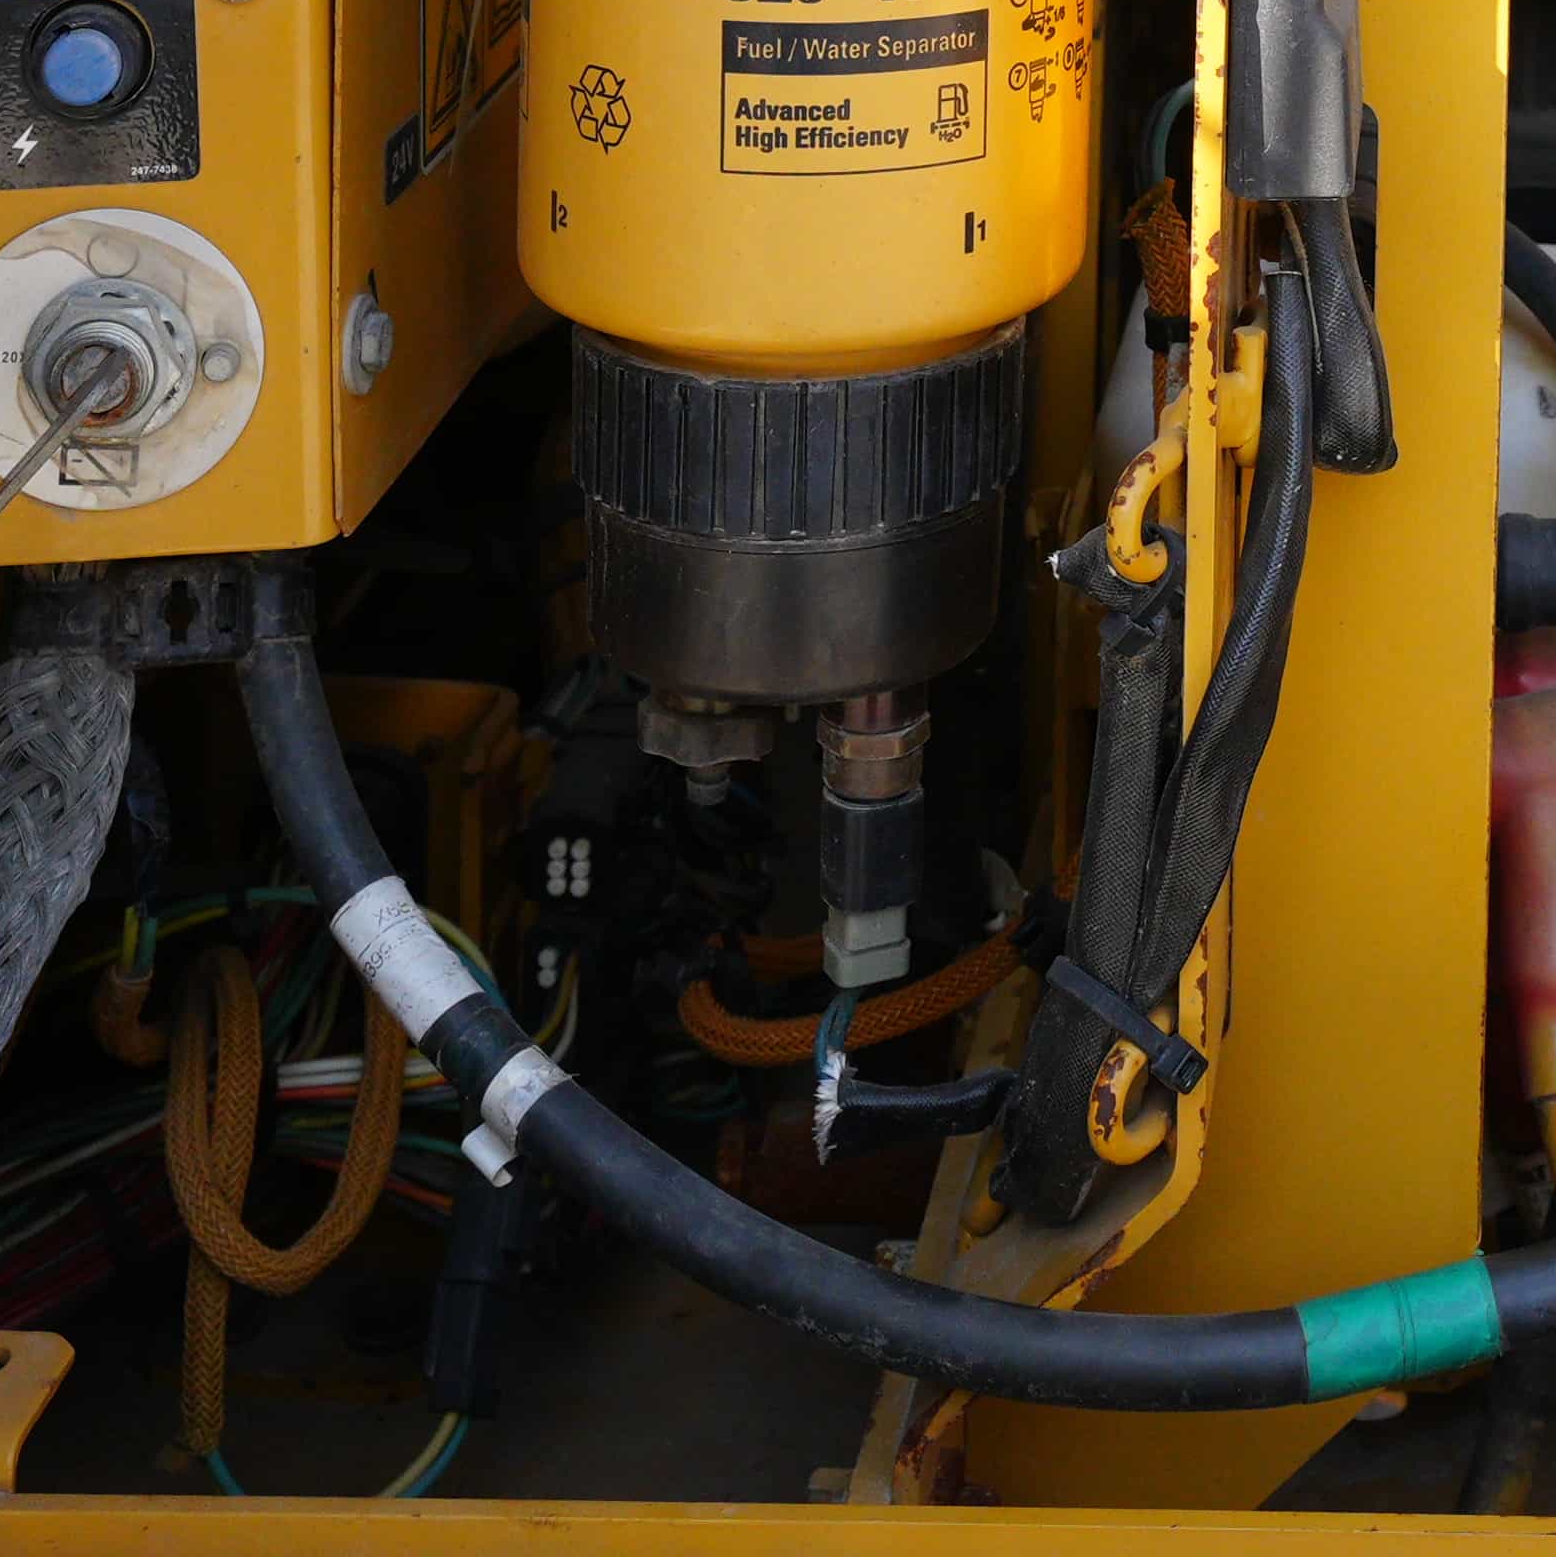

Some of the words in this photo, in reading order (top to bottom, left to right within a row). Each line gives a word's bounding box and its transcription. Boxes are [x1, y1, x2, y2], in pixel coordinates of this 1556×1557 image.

[736, 36, 782, 59] Fuel
[803, 37, 872, 61] Water
[877, 29, 977, 60] Separator
[734, 97, 851, 121] Advanced
[735, 125, 788, 153] High
[794, 126, 910, 150] Efficiency
